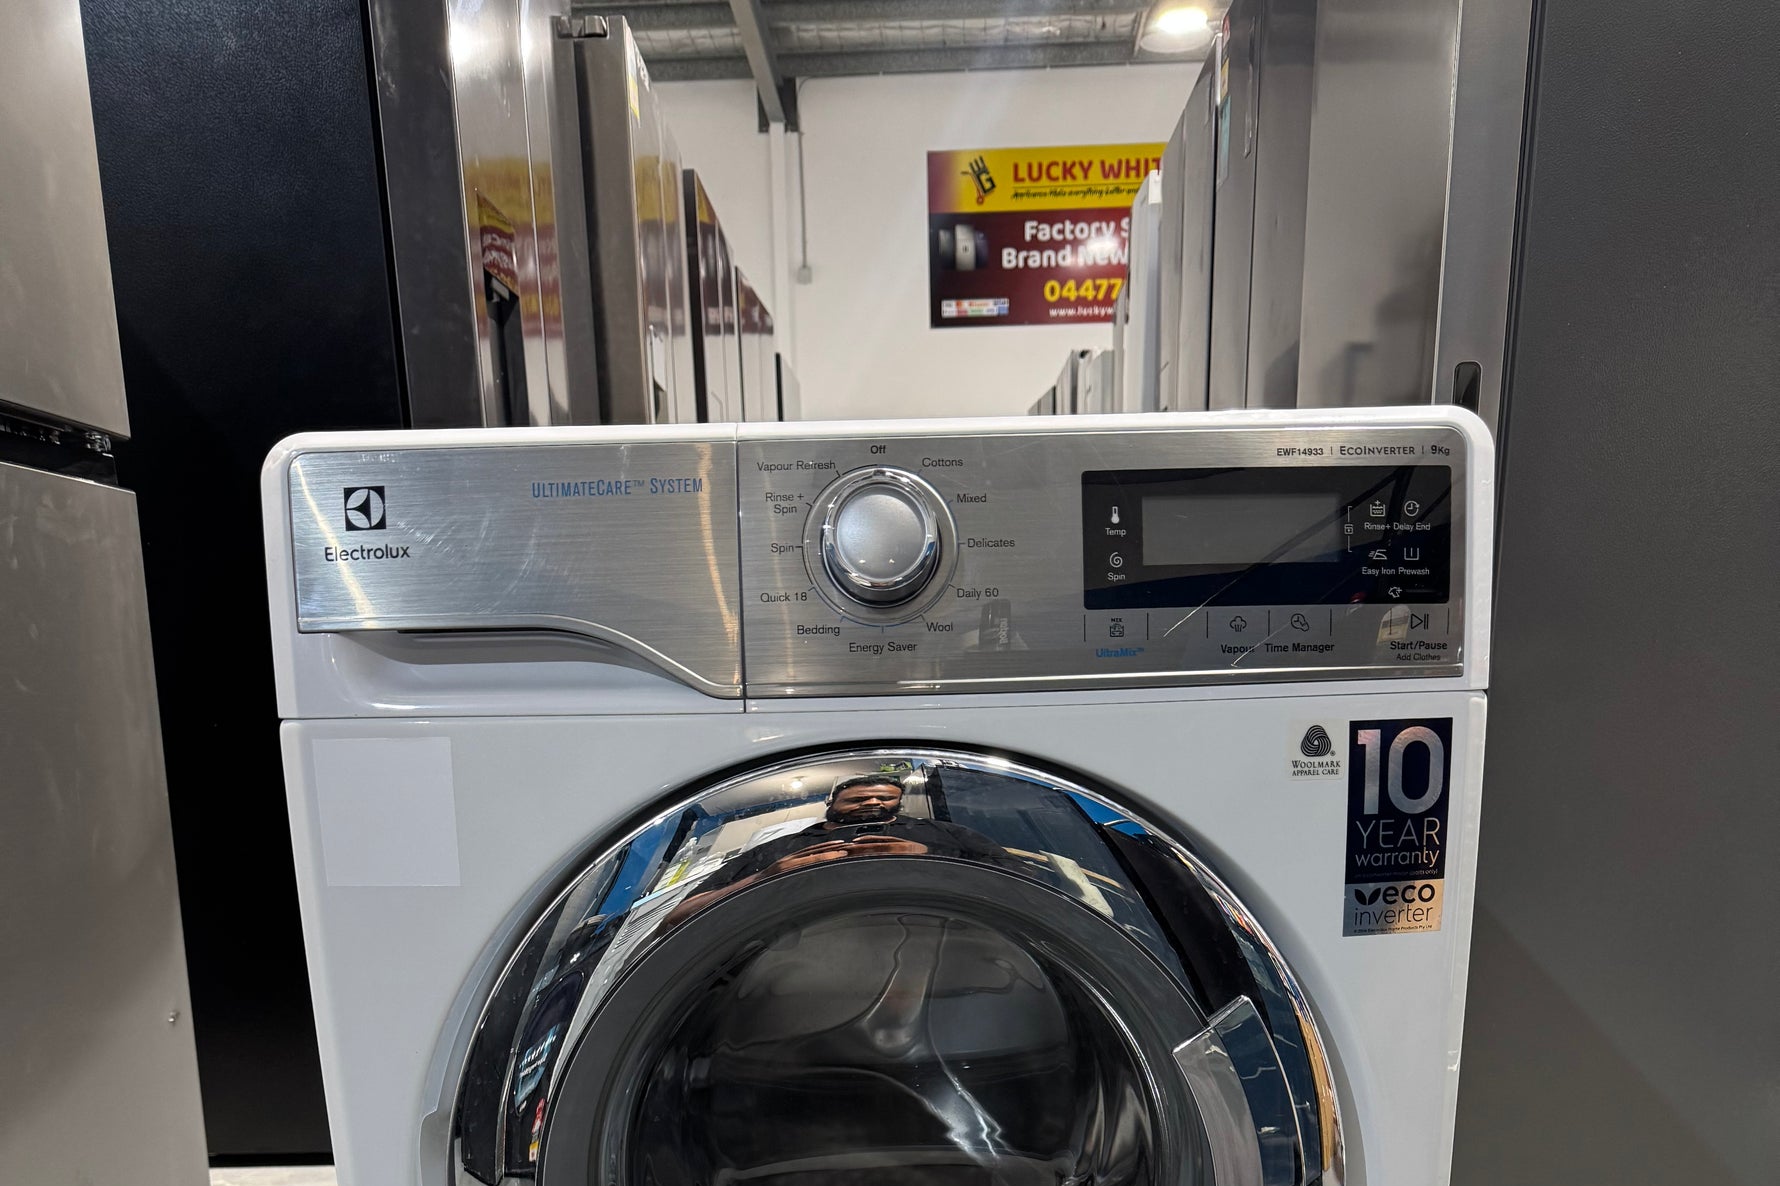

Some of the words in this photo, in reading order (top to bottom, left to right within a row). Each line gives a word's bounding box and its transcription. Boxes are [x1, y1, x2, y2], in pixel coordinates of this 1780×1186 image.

[1013, 160, 1093, 183] LUCKY
[1024, 220, 1116, 242] Factory
[1001, 244, 1072, 269] Brand
[870, 445, 886, 455] Off
[1276, 447, 1324, 456] EWF14933
[757, 461, 793, 472] Vapour
[796, 460, 836, 470] Refresh
[922, 457, 963, 468] Cottons
[765, 493, 795, 502] Rinse
[956, 493, 987, 503] Mixed
[773, 504, 797, 515] Spin
[1105, 528, 1126, 537] Temp
[1393, 522, 1414, 532] Delay
[770, 543, 795, 554] Spin
[967, 538, 1015, 549] Delicates
[324, 544, 410, 563] Electrolux
[1108, 572, 1125, 582] Spin
[1362, 567, 1379, 576] Easy
[1398, 567, 1429, 575] Prewash
[760, 592, 792, 603] Quick
[794, 592, 808, 602] 18
[956, 588, 981, 600] Daily
[984, 588, 999, 598] 60
[796, 625, 840, 636] Bedding
[925, 622, 953, 632] Wool
[848, 642, 884, 655] Energy
[887, 642, 918, 652] Saver
[1220, 644, 1254, 655] Vapour
[1264, 643, 1289, 652] Time
[1290, 643, 1335, 653] Manager
[1389, 640, 1448, 650] Start/Pause
[1396, 653, 1412, 661] Add
[1413, 653, 1441, 661] Clothes
[1291, 760, 1341, 769] WOOLMARK
[1322, 768, 1339, 776] CARE
[1357, 726, 1444, 815] 10
[1355, 817, 1440, 849] YEAR
[1355, 845, 1440, 868] warranty
[1382, 883, 1435, 905] eco
[1354, 904, 1433, 926] inverter
